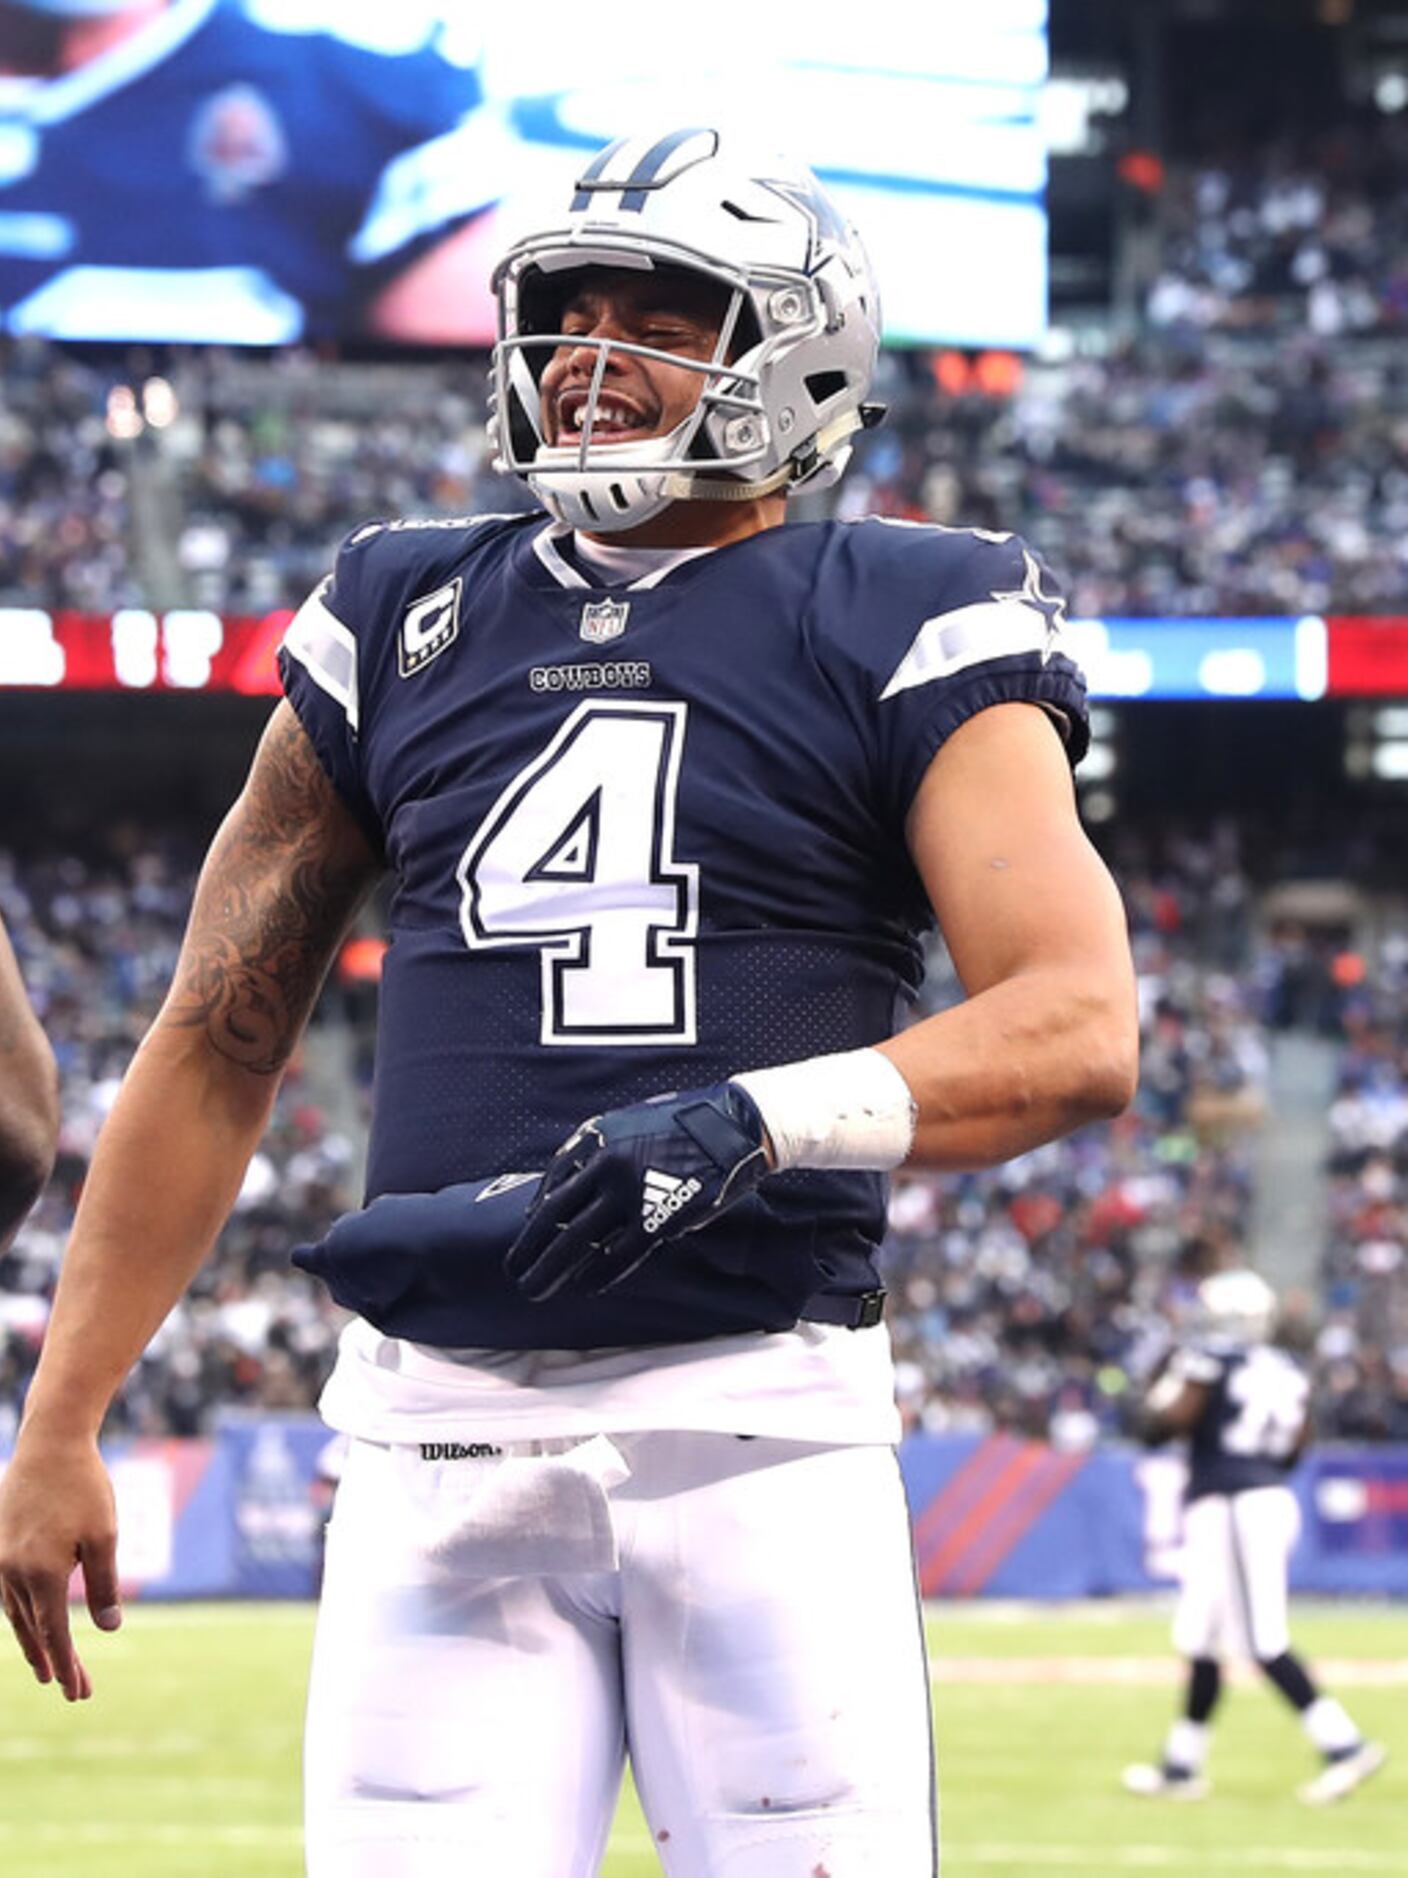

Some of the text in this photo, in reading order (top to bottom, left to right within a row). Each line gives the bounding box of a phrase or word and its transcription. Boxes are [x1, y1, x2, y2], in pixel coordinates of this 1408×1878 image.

[403, 587, 455, 654] C
[584, 617, 621, 637] NFL
[529, 662, 652, 692] COWBOYS
[455, 698, 700, 1046] 4
[643, 1177, 703, 1233] adidas
